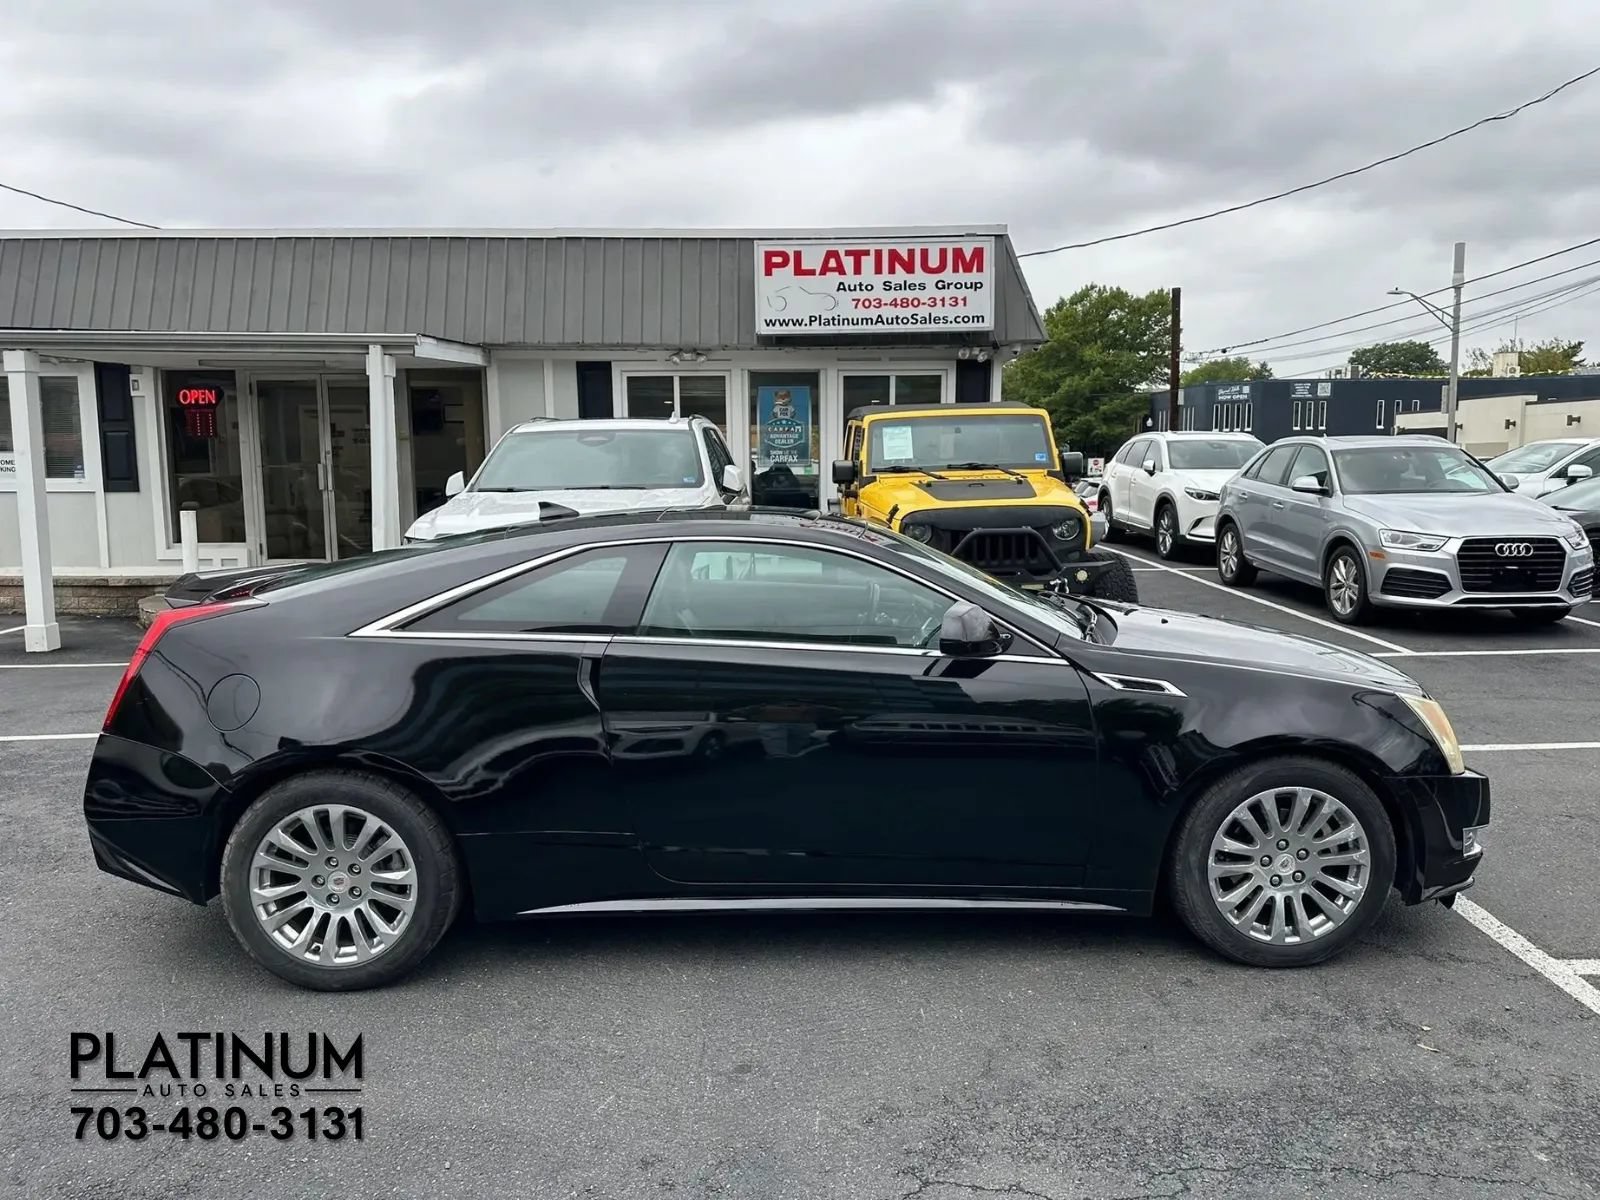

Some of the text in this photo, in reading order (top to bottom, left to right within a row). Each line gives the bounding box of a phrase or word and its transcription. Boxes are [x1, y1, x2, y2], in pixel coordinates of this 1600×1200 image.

[763, 247, 984, 277] PLATINUM
[836, 279, 984, 292] Auto Sales Group
[851, 296, 968, 309] 703-480-3131
[764, 313, 985, 328] www.PlatinumAutoSales.com
[179, 389, 216, 404] OPEN
